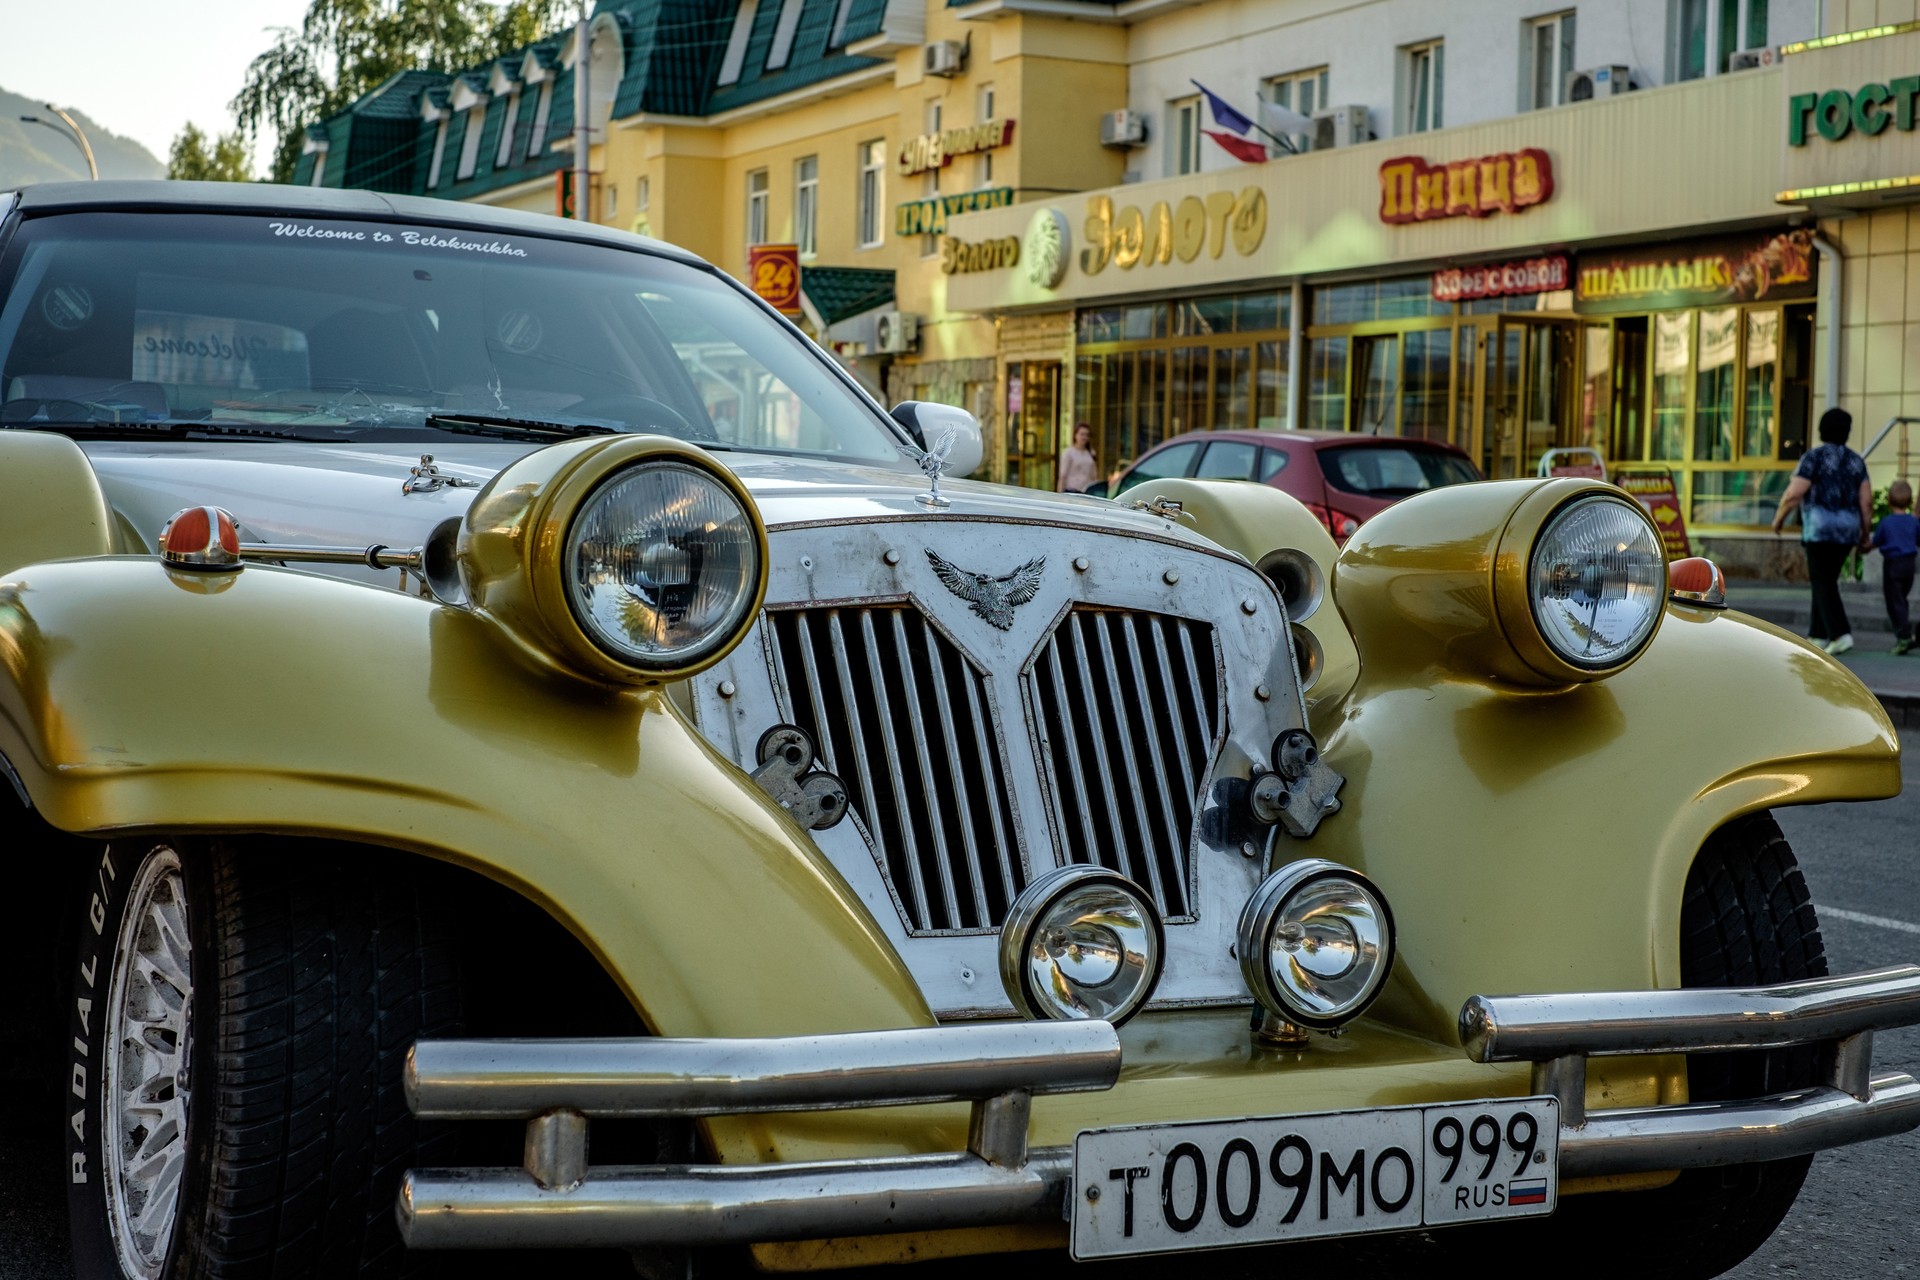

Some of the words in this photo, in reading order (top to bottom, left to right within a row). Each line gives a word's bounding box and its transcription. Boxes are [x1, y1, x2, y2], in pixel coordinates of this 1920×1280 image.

[1789, 75, 1920, 147] ГОСТ
[1382, 155, 1543, 217] Пицца
[269, 222, 367, 242] Welcome
[373, 231, 394, 243] to
[400, 231, 528, 258] Belokurikha
[757, 262, 792, 289] 24
[1435, 272, 1483, 296] КОФЕ
[1503, 261, 1563, 288] СОБОЙ
[1582, 256, 1729, 296] ШАШЛЫК
[71, 955, 98, 1184] RADIAL
[89, 844, 116, 935] G/T
[1433, 1111, 1538, 1183] 999
[1455, 1184, 1506, 1210] RUS
